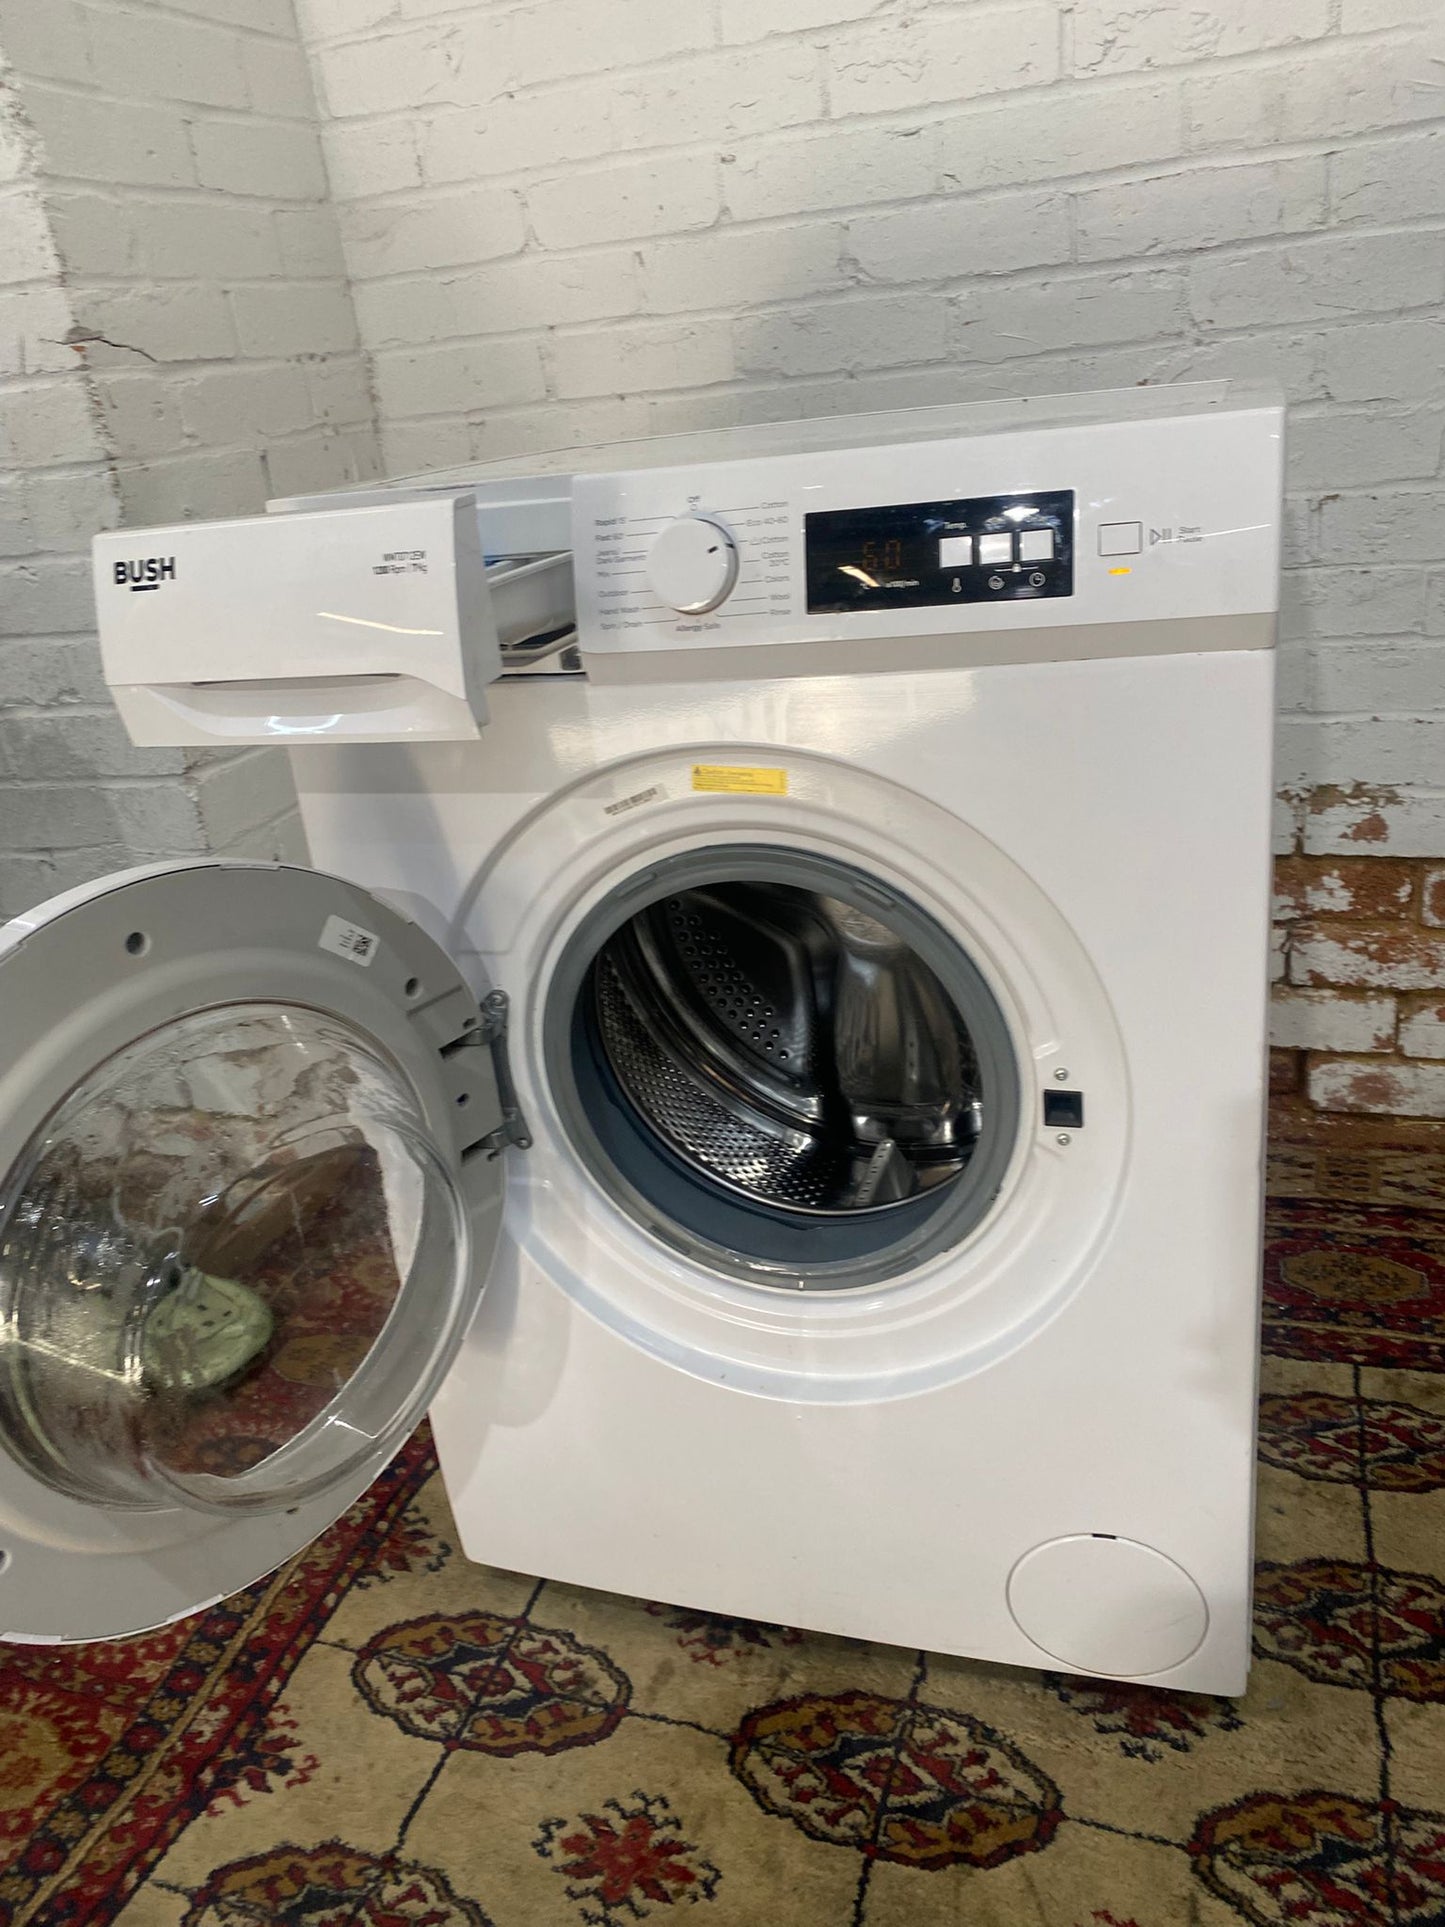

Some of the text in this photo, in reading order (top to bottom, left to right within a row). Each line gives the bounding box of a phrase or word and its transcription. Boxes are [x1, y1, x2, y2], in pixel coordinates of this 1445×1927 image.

[761, 501, 788, 510] Cotton
[595, 518, 616, 527] Rapid
[747, 515, 788, 527] Eco 40-60
[1178, 525, 1202, 535] Start
[761, 536, 788, 545] Cotton
[762, 551, 788, 560] Cotton
[862, 539, 901, 572] 60
[113, 556, 176, 584] BUSH
[599, 589, 628, 598] Outdoor
[600, 606, 639, 616] Hand Wash
[769, 608, 791, 617] Rinse
[676, 624, 701, 633] Allergy
